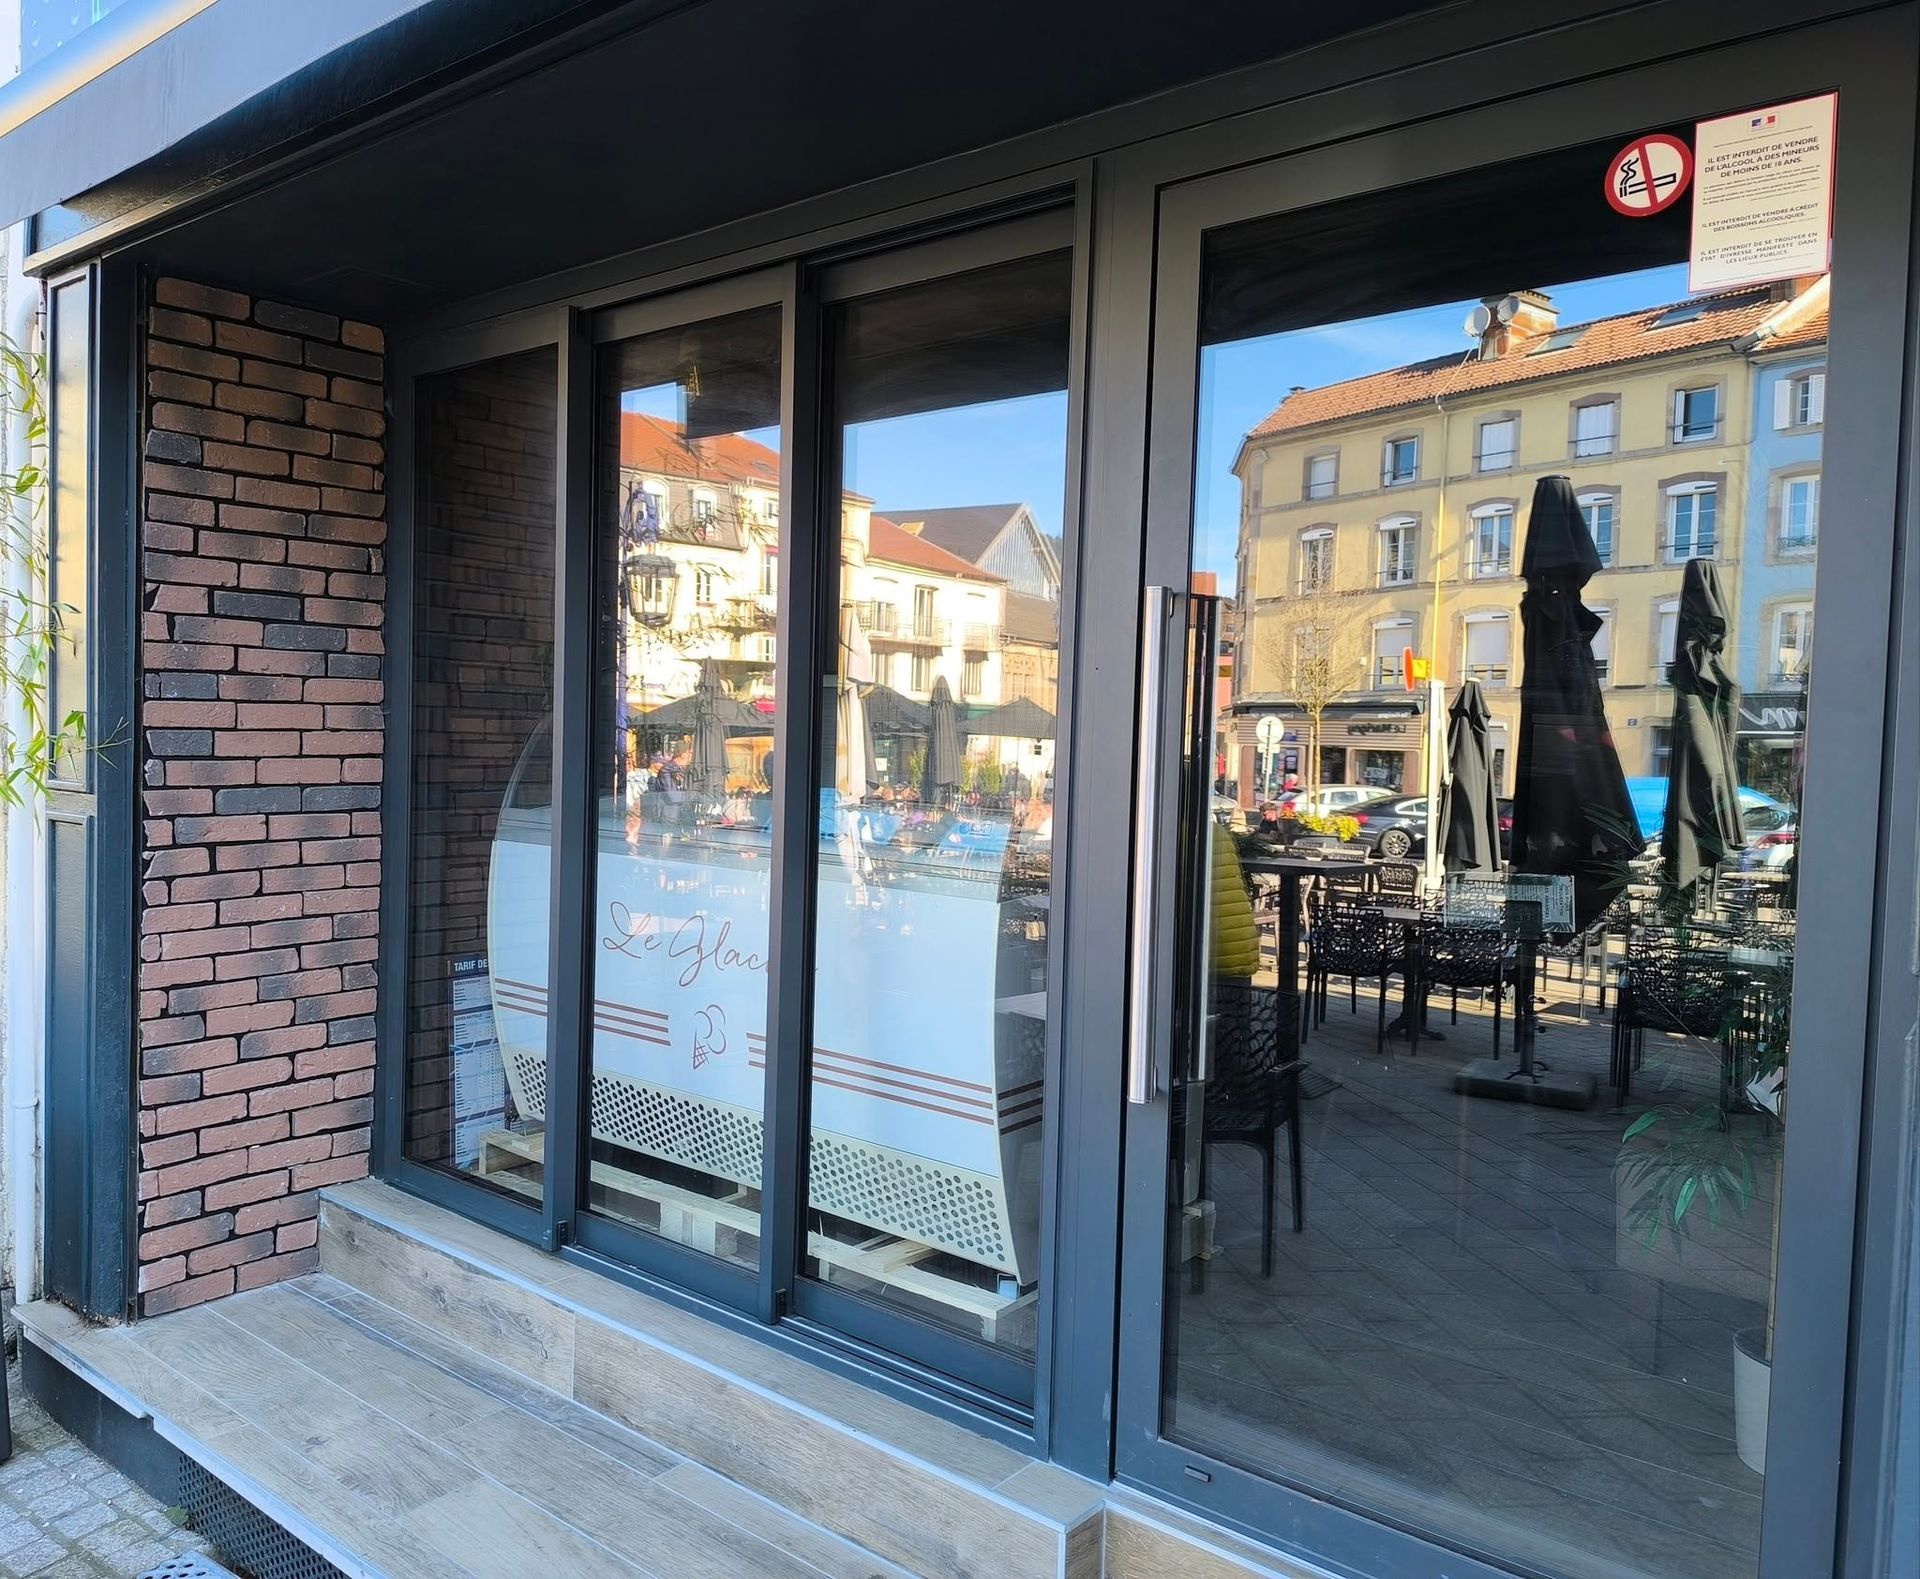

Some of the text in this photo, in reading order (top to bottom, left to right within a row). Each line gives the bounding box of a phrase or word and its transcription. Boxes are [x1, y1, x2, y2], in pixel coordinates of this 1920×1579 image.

[1716, 154, 1731, 162] EST
[1733, 147, 1770, 159] INTERDIT
[1771, 143, 1782, 151] DE
[1785, 137, 1818, 148] VENDRE
[1704, 165, 1716, 173] DE
[1717, 157, 1755, 171] L'ALCOOL
[1764, 152, 1781, 161] DES
[1783, 145, 1819, 157] MINEURS
[1732, 165, 1760, 176] MOINS
[1761, 162, 1773, 170] DE
[1720, 215, 1751, 225] INTERDIT
[1762, 208, 1788, 218] VENDRE
[1726, 219, 1758, 230] BOISSONS
[1721, 242, 1752, 253] INTERDIT
[1774, 233, 1806, 243] TROUVER
[1756, 242, 1793, 253] MANIFESTE
[1798, 238, 1818, 247] DANS
[1738, 254, 1758, 262] LIEUX
[603, 901, 769, 987] Le Glac
[453, 959, 476, 972] TARIF
